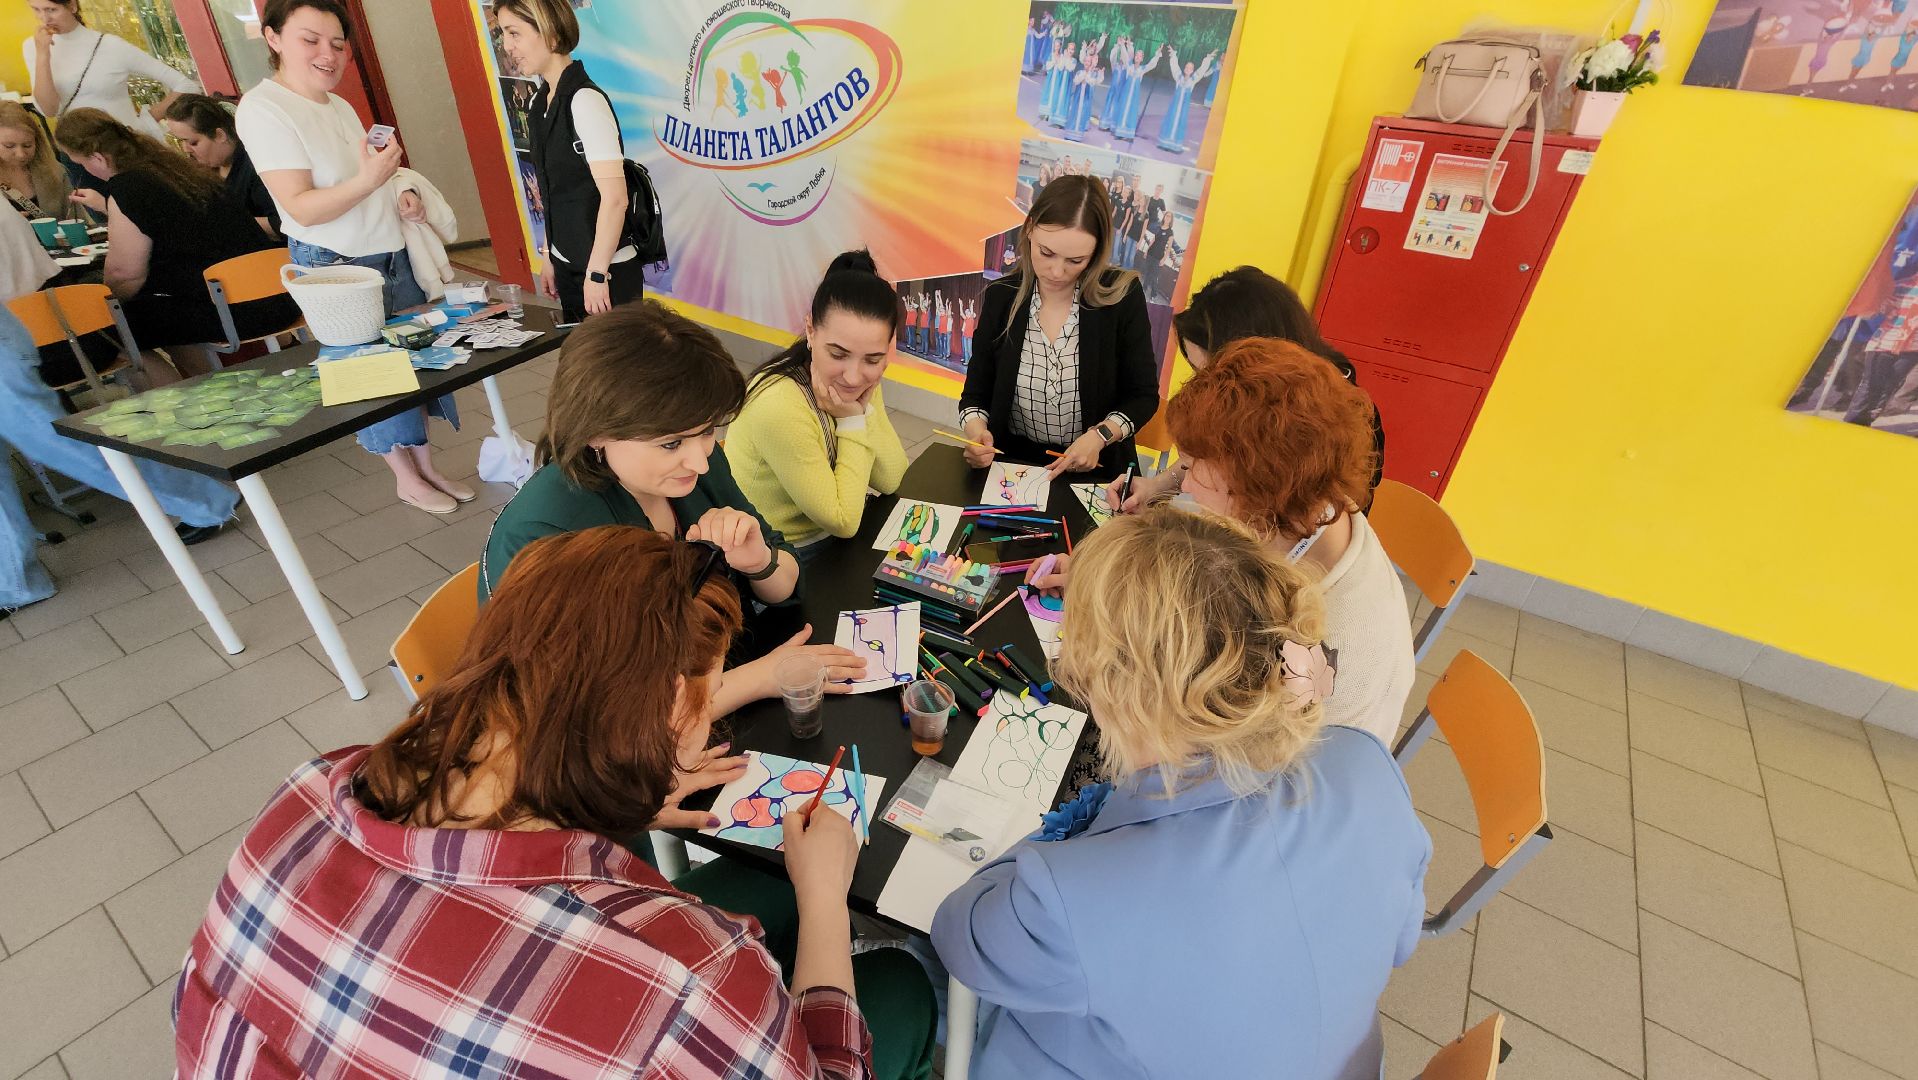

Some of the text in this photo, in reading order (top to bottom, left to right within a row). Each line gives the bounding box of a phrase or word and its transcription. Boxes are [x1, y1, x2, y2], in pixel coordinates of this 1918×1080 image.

[700, 25, 706, 33] и
[662, 67, 870, 161] ПЛАНЕТА ТАЛАНТОВ
[767, 167, 826, 210] Городской округ Лобня
[1368, 180, 1400, 194] ПК-7
